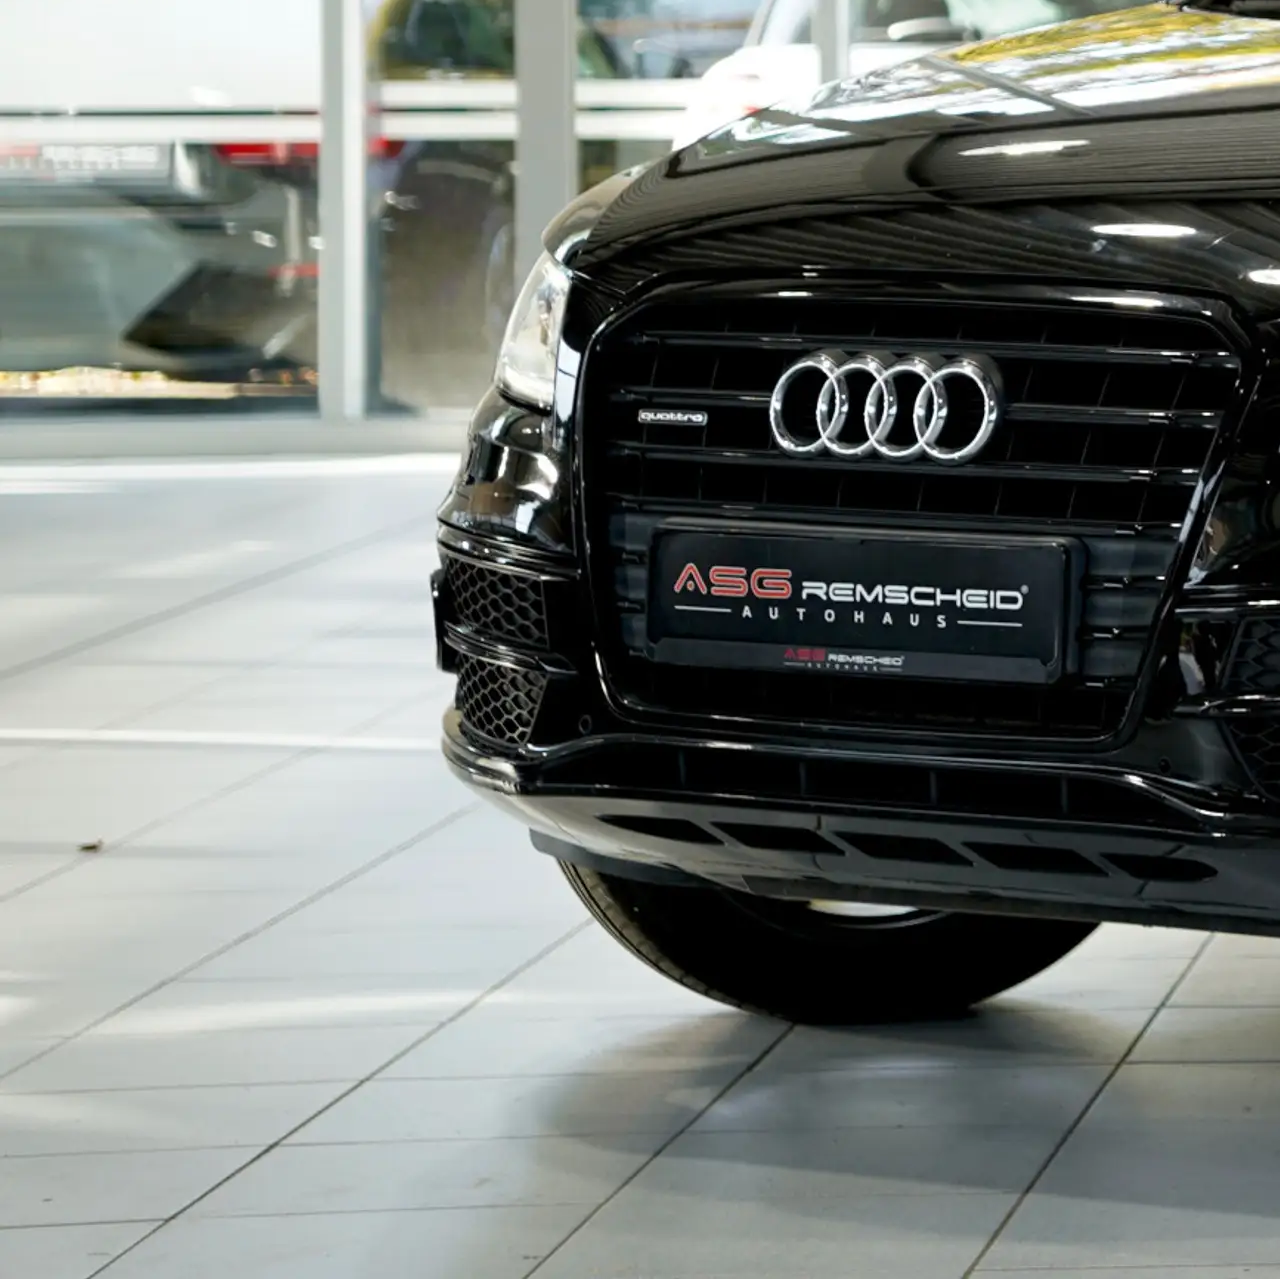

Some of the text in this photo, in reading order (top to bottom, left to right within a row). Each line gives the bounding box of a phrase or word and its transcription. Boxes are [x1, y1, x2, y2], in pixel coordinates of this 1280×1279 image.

[641, 412, 704, 422] quattro
[674, 563, 792, 598] ASG
[742, 605, 947, 628] AUTOHAUS
